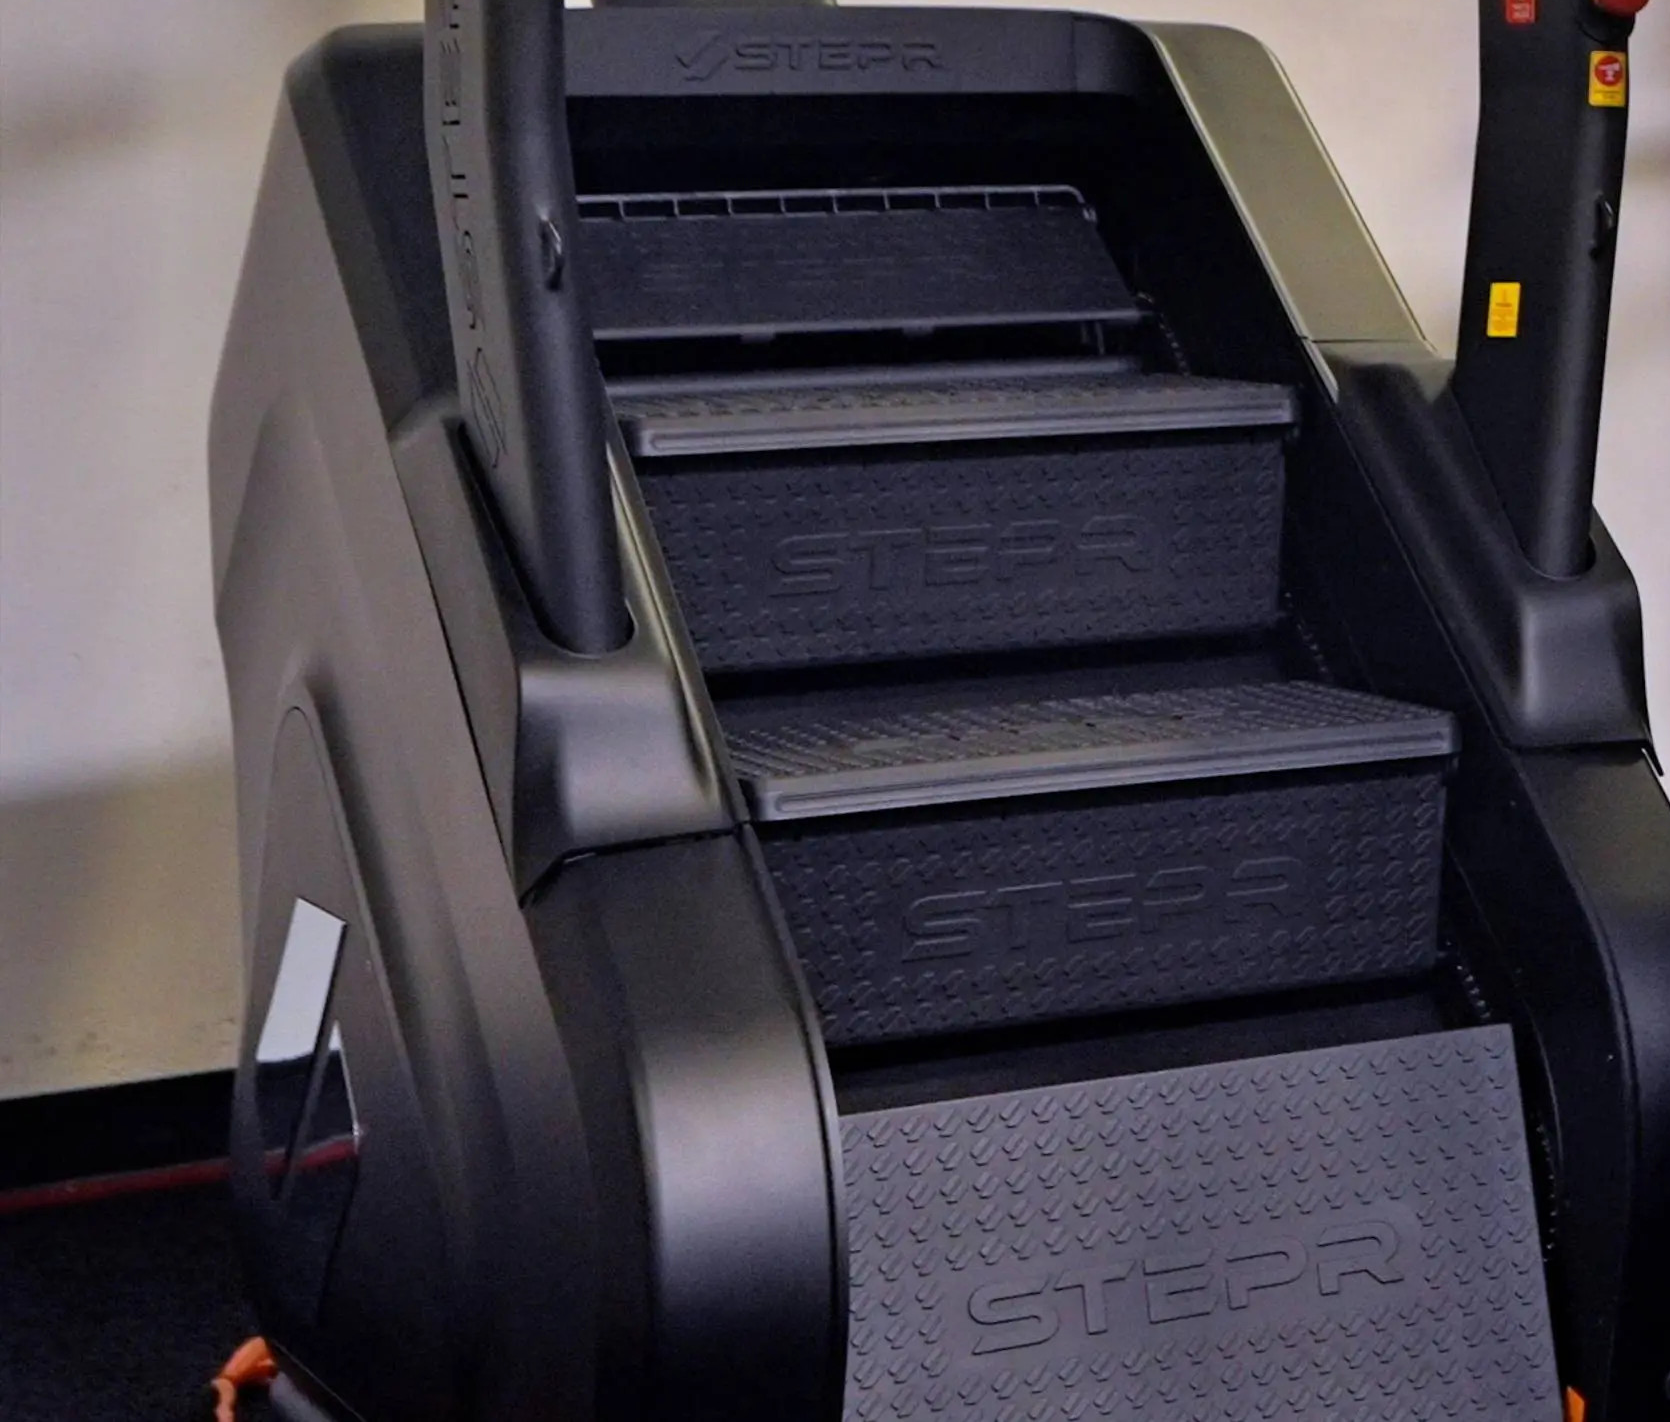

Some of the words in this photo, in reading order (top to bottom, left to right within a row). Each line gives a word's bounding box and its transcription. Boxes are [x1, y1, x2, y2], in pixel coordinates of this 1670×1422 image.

[732, 36, 949, 72] STEPR
[769, 514, 1155, 599] STEPR
[901, 856, 1304, 964] STEPR
[967, 1216, 1408, 1356] STEPR
